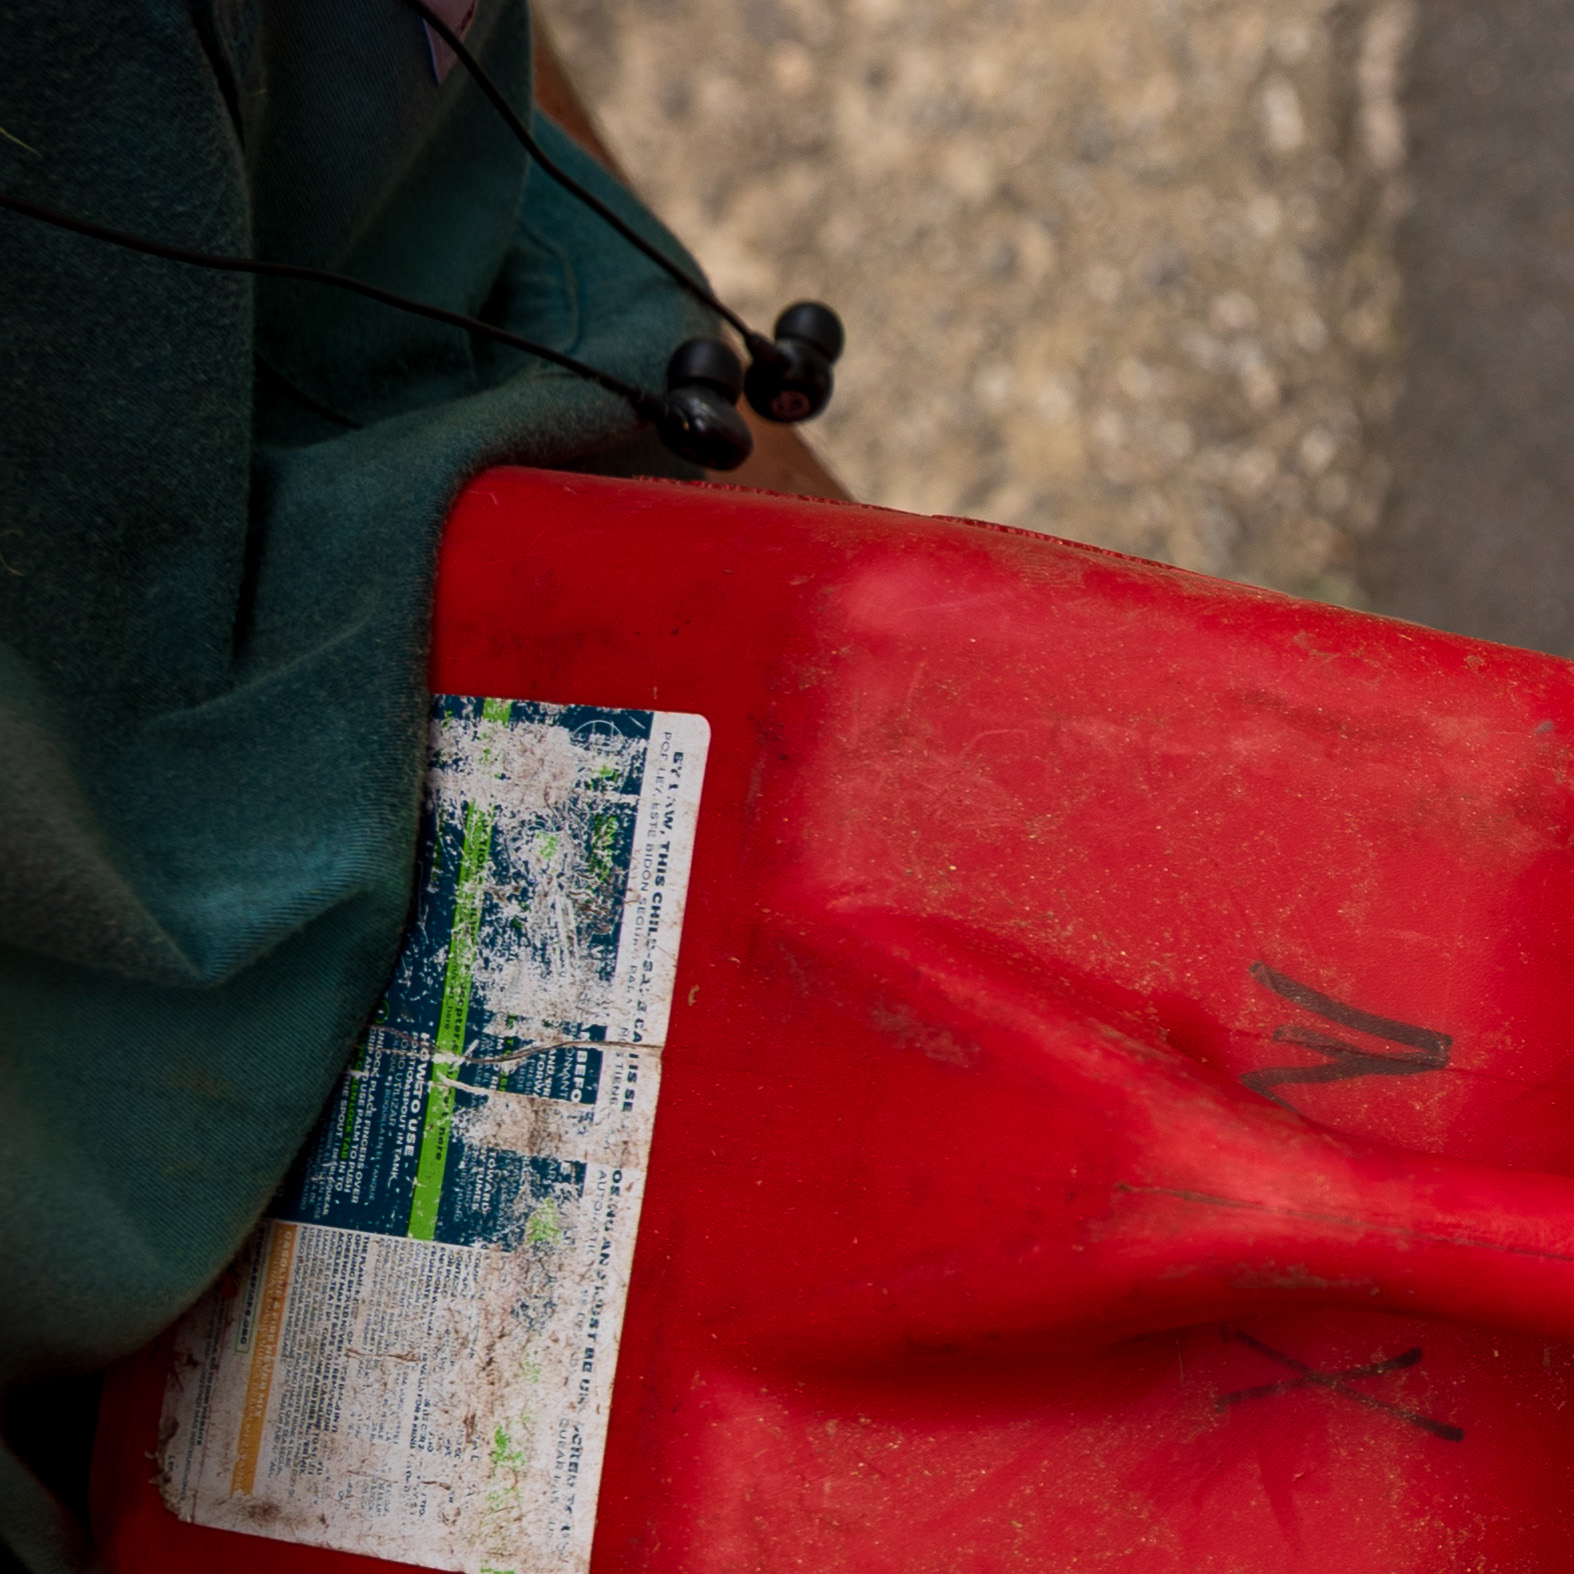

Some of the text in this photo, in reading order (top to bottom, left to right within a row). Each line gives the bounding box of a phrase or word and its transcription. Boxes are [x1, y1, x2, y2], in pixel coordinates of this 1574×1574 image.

[653, 839, 670, 887] THIS
[634, 891, 663, 1012] CHILD-SAE
[414, 1032, 432, 1079] HOW
[625, 1063, 638, 1083] IS
[356, 1083, 367, 1107] USE
[363, 1079, 377, 1117] PLACE
[397, 1090, 410, 1129] SPOUT
[333, 1060, 363, 1192] GEEN LOCK TAB IN TO
[351, 1108, 363, 1142] PALM
[395, 1132, 403, 1145] IN
[403, 1118, 418, 1157] USE
[348, 1143, 358, 1160] TO
[355, 1119, 371, 1170] FINGERS
[342, 1160, 355, 1193] PUSH
[389, 1147, 401, 1181] TANK
[350, 1170, 363, 1204] OVER
